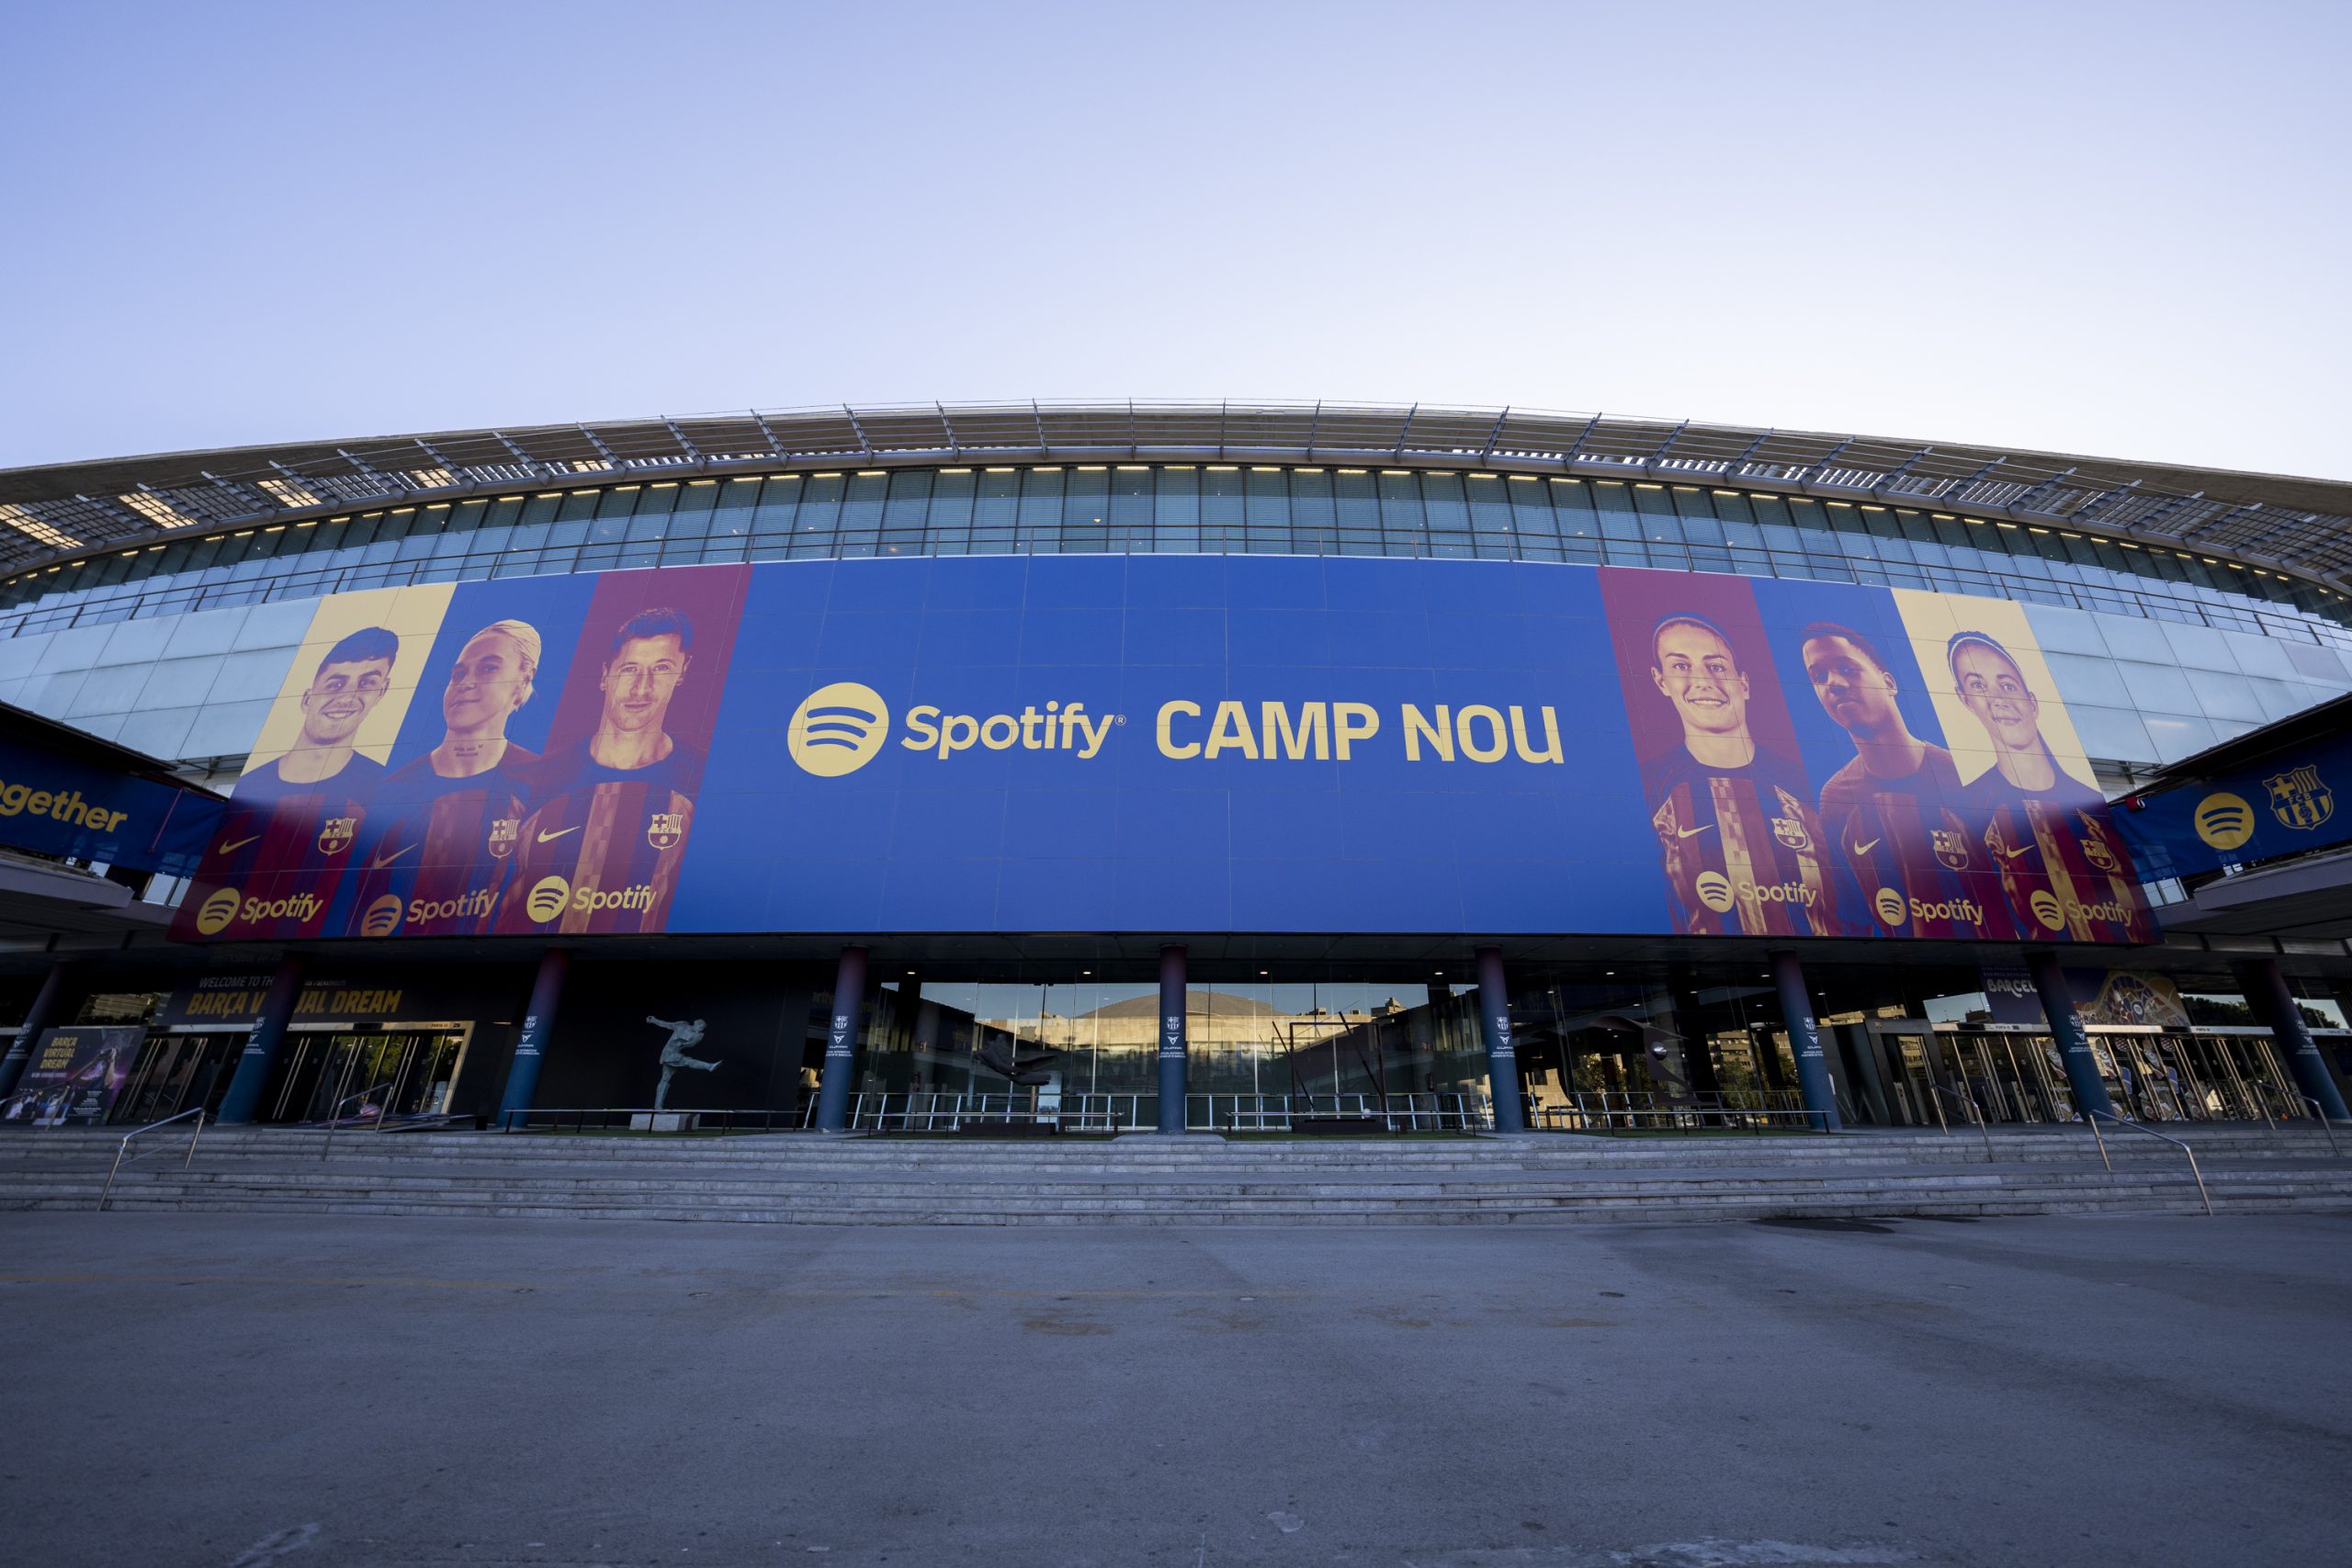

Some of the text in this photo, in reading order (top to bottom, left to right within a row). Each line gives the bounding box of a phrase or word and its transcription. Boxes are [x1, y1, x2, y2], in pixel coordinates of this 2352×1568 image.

[1156, 700, 1380, 761] CAMP
[1401, 704, 1565, 764] NOU
[0, 779, 129, 833] gether
[240, 893, 323, 924] Spotify
[405, 888, 500, 924] Spotify
[571, 884, 657, 914] Spotify
[1737, 881, 1817, 917] Spotify
[1909, 897, 1984, 926] Spotify
[2065, 899, 2132, 927] Spotify
[198, 976, 276, 988] WELCOME TO TH
[1986, 978, 2038, 998] BARCEL
[186, 991, 249, 1020] BARÇA
[329, 989, 404, 1014] DREAM
